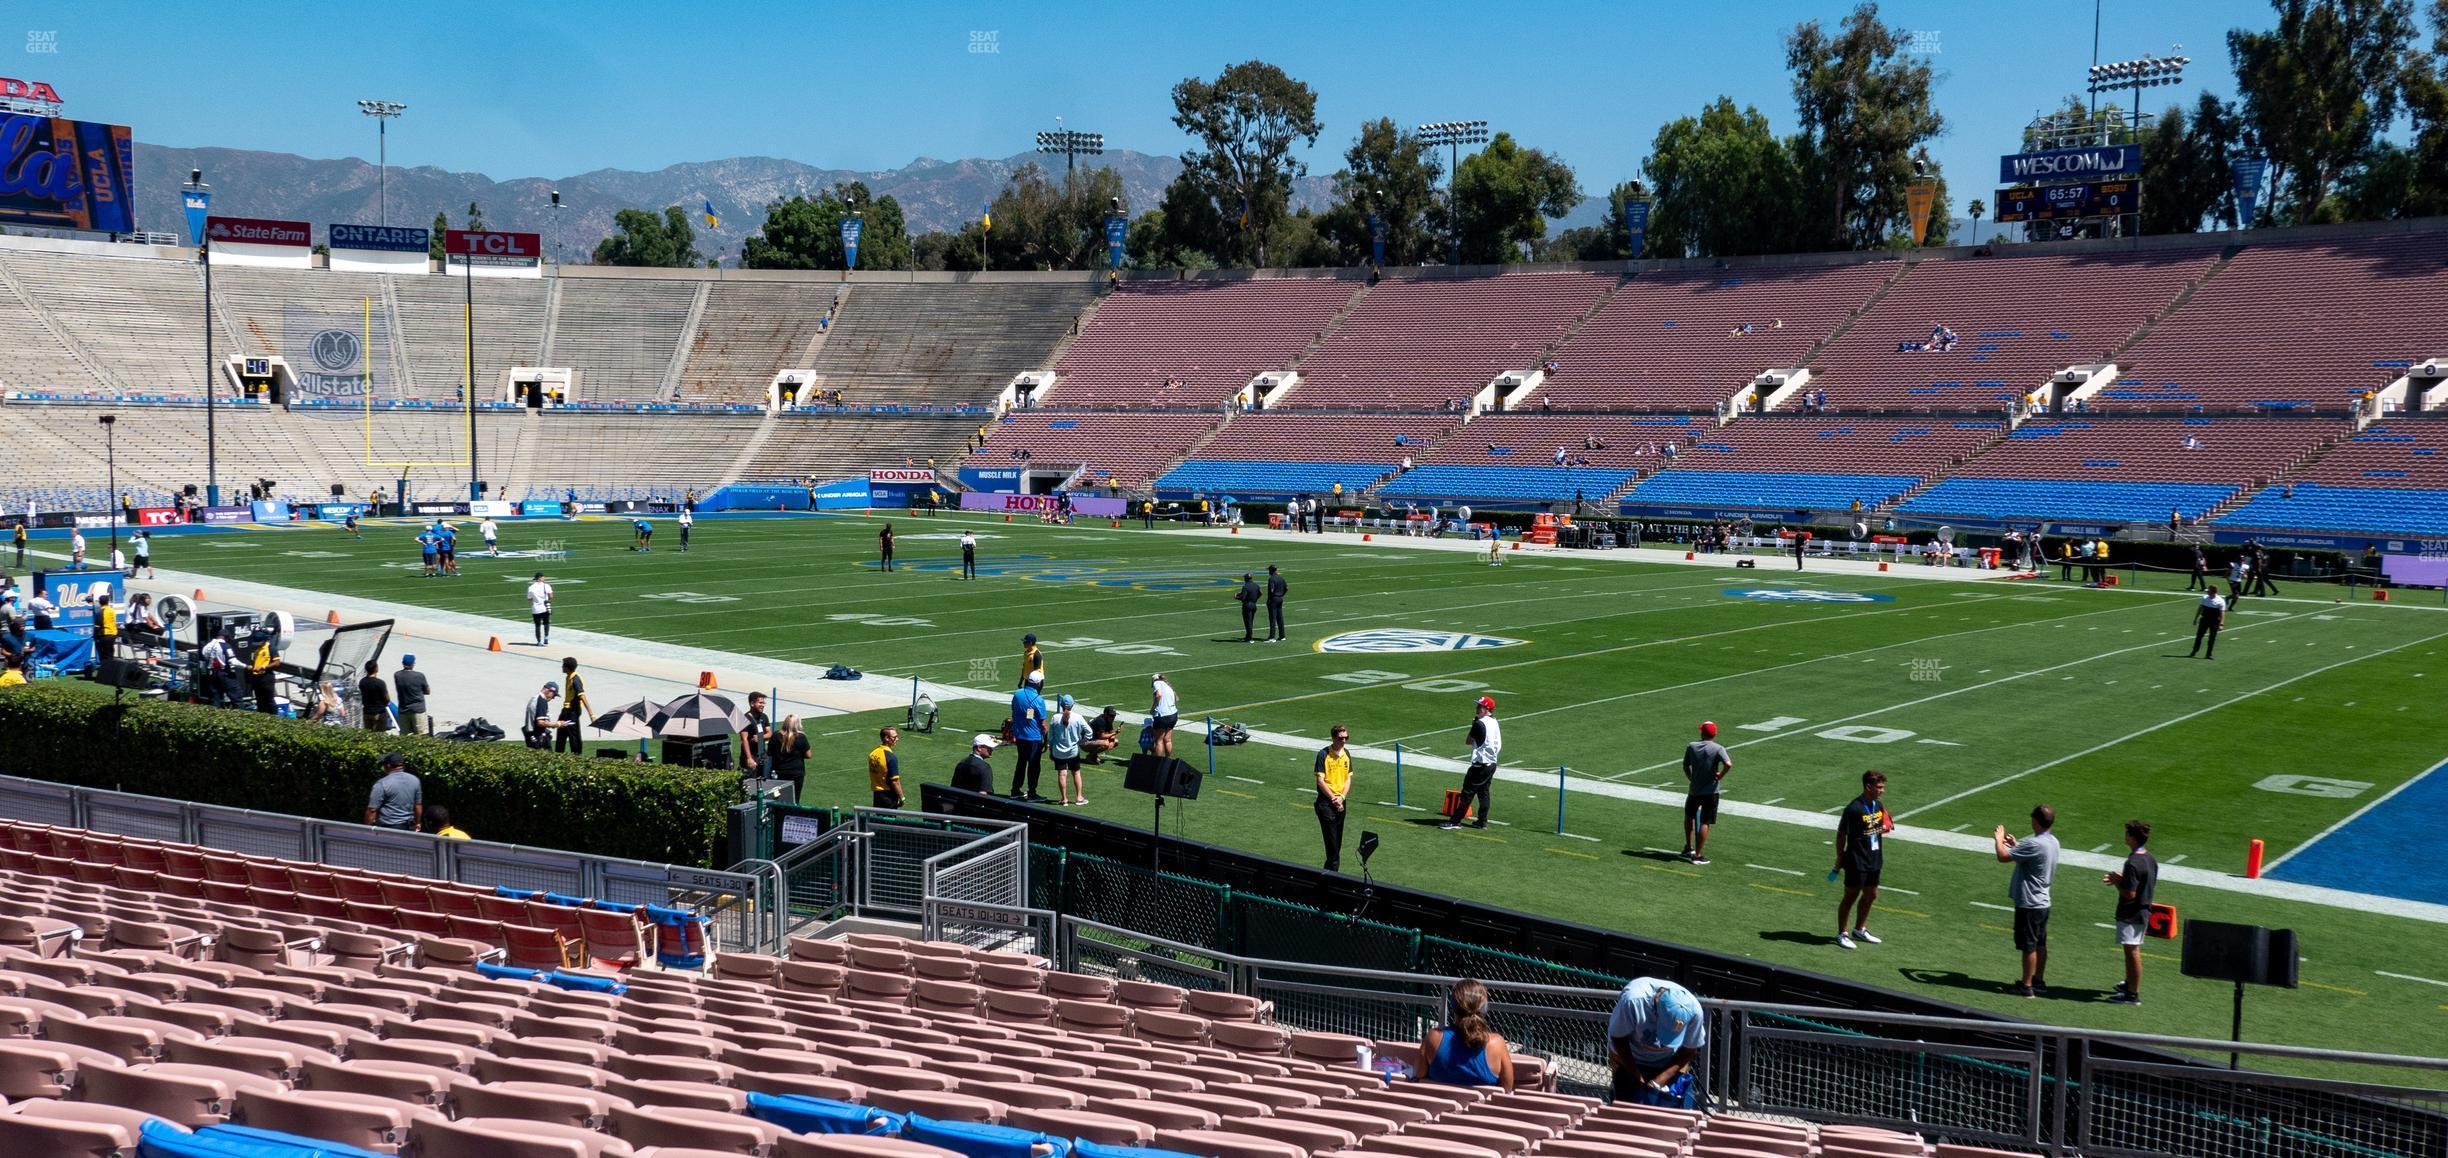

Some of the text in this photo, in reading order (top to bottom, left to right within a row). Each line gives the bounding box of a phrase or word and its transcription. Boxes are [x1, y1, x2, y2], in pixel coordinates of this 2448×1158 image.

[2013, 152, 2099, 176] WESCOM
[88, 148, 113, 202] UCLA
[2009, 190, 2034, 200] UCLA
[2050, 187, 2084, 200] 65:57
[2110, 195, 2118, 205] 0
[2016, 201, 2023, 211] 0
[332, 226, 427, 244] ONTARIO
[2059, 226, 2073, 236] 42
[463, 234, 524, 253] TCL
[247, 359, 268, 374] 40
[300, 373, 373, 396] Allstate
[872, 470, 932, 480] HONDA
[979, 471, 1017, 479] MUSCLE MILK
[1647, 523, 1662, 533] AT
[1665, 524, 1688, 534] THE
[2061, 526, 2085, 534] MUSCLE
[640, 592, 742, 604] 50
[1036, 637, 1174, 655] 30
[1317, 669, 1489, 692] 20
[1737, 716, 1916, 744] 10
[2251, 774, 2376, 798] G
[692, 876, 741, 890] SEATS 1-30
[942, 906, 1009, 923] SEATS 101-130
